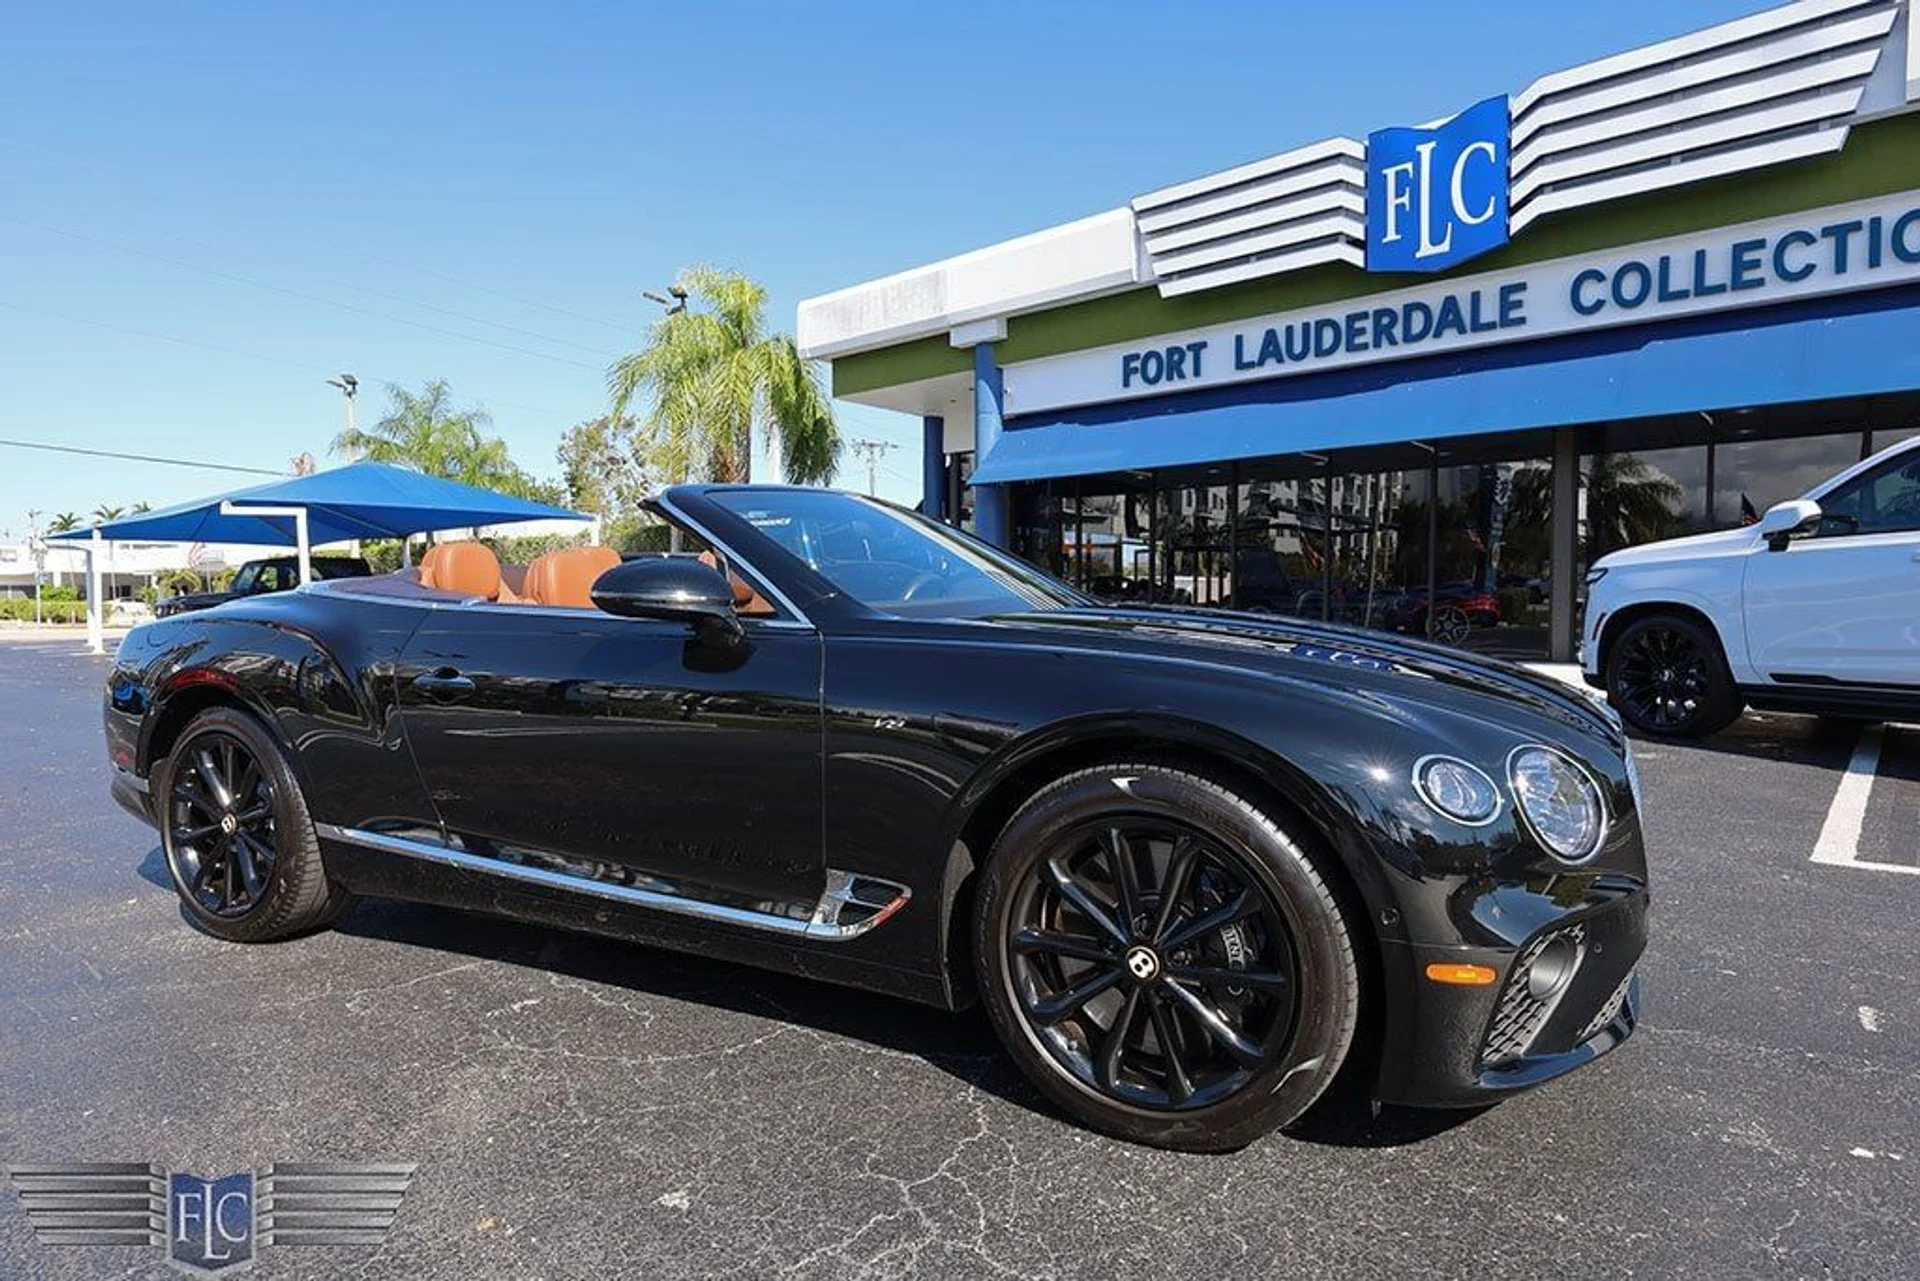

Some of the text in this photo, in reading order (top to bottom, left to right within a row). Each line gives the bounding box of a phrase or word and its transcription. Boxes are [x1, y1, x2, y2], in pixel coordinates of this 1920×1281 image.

[1382, 141, 1496, 258] FLC
[1122, 341, 1207, 388] FORT
[1234, 282, 1527, 370] LAUDERDALE
